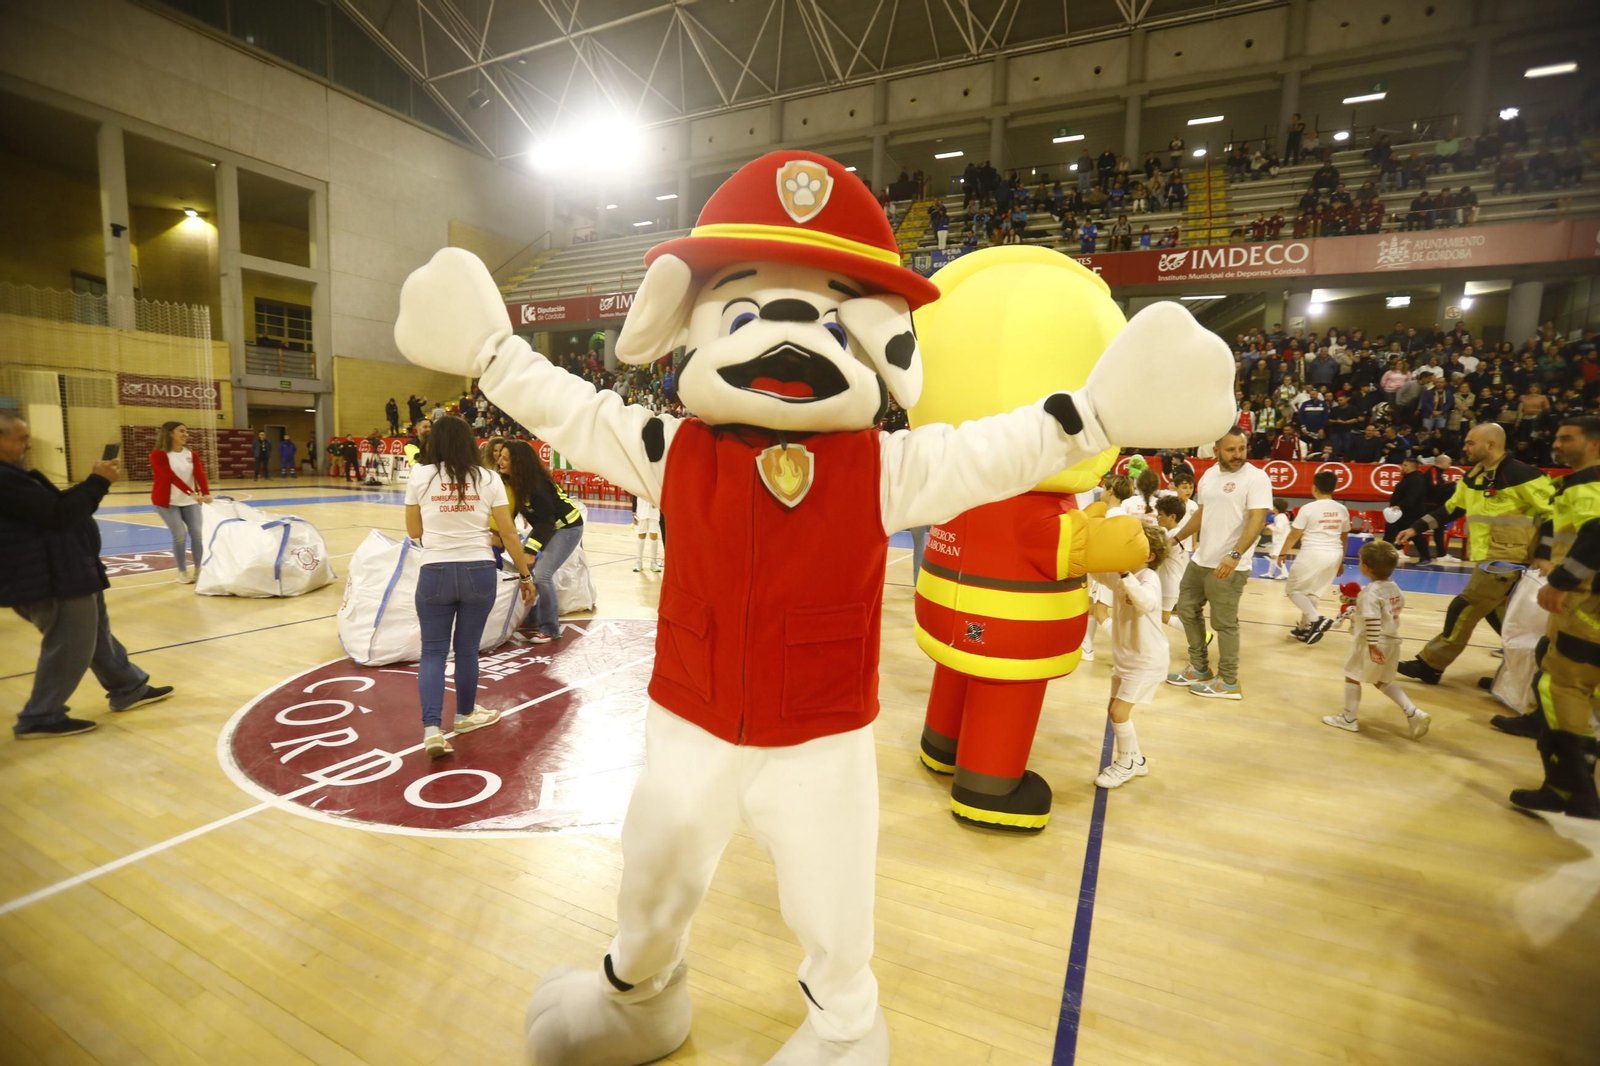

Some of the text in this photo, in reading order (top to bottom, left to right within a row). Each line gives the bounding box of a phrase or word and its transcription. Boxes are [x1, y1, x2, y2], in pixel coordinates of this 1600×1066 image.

[1413, 235, 1486, 250] AYUNTAMIENTO
[1191, 243, 1310, 271] IMDECO
[1412, 251, 1425, 262] DE
[1158, 274, 1187, 282] Instituto
[1188, 272, 1224, 280] Municipal
[1236, 269, 1271, 278] Deportes
[1272, 267, 1306, 275] Córdoba
[616, 294, 637, 310] IM
[146, 383, 217, 399] IMDECO
[440, 505, 475, 513] COLABORAN
